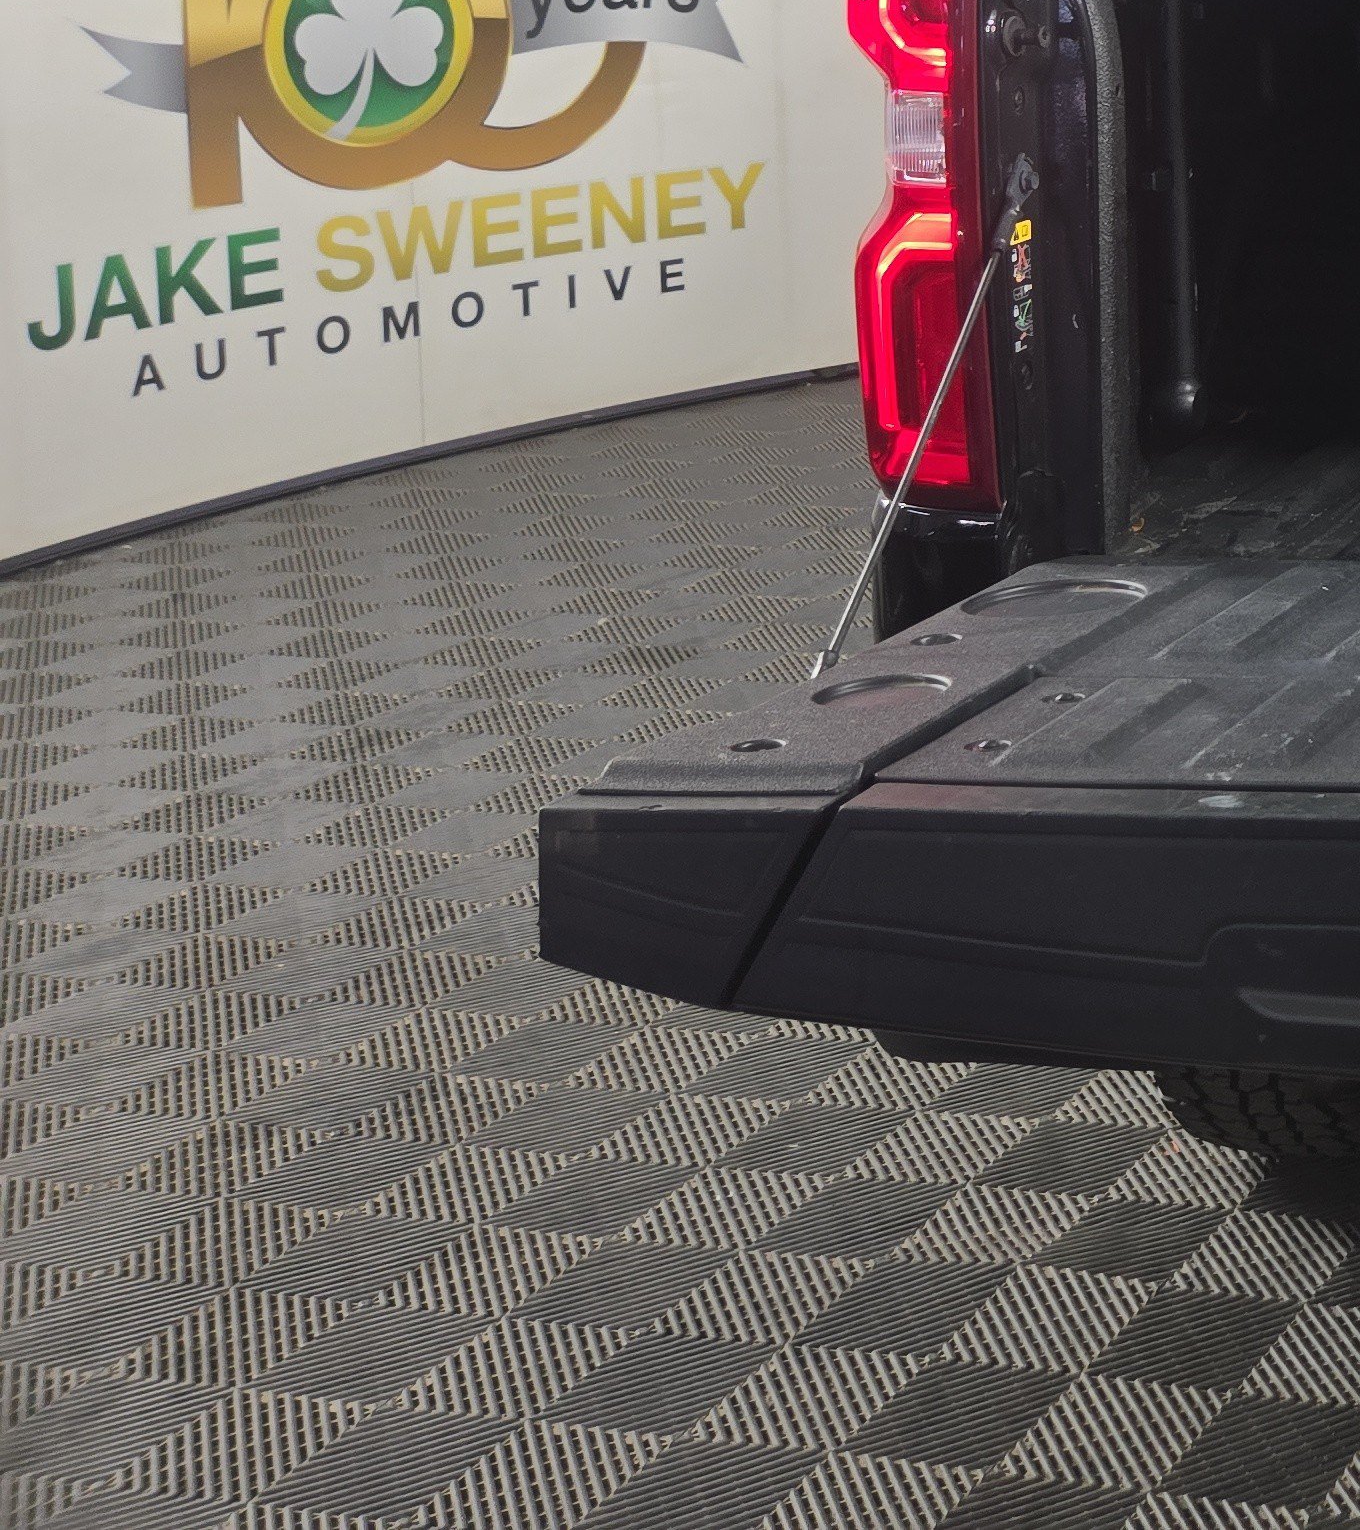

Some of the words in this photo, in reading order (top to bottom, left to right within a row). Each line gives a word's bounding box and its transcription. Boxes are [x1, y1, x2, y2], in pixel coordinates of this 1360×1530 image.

[27, 226, 285, 351] JAKE
[315, 162, 766, 294] SWEENEY
[131, 258, 687, 397] AUTOMOTIVE
